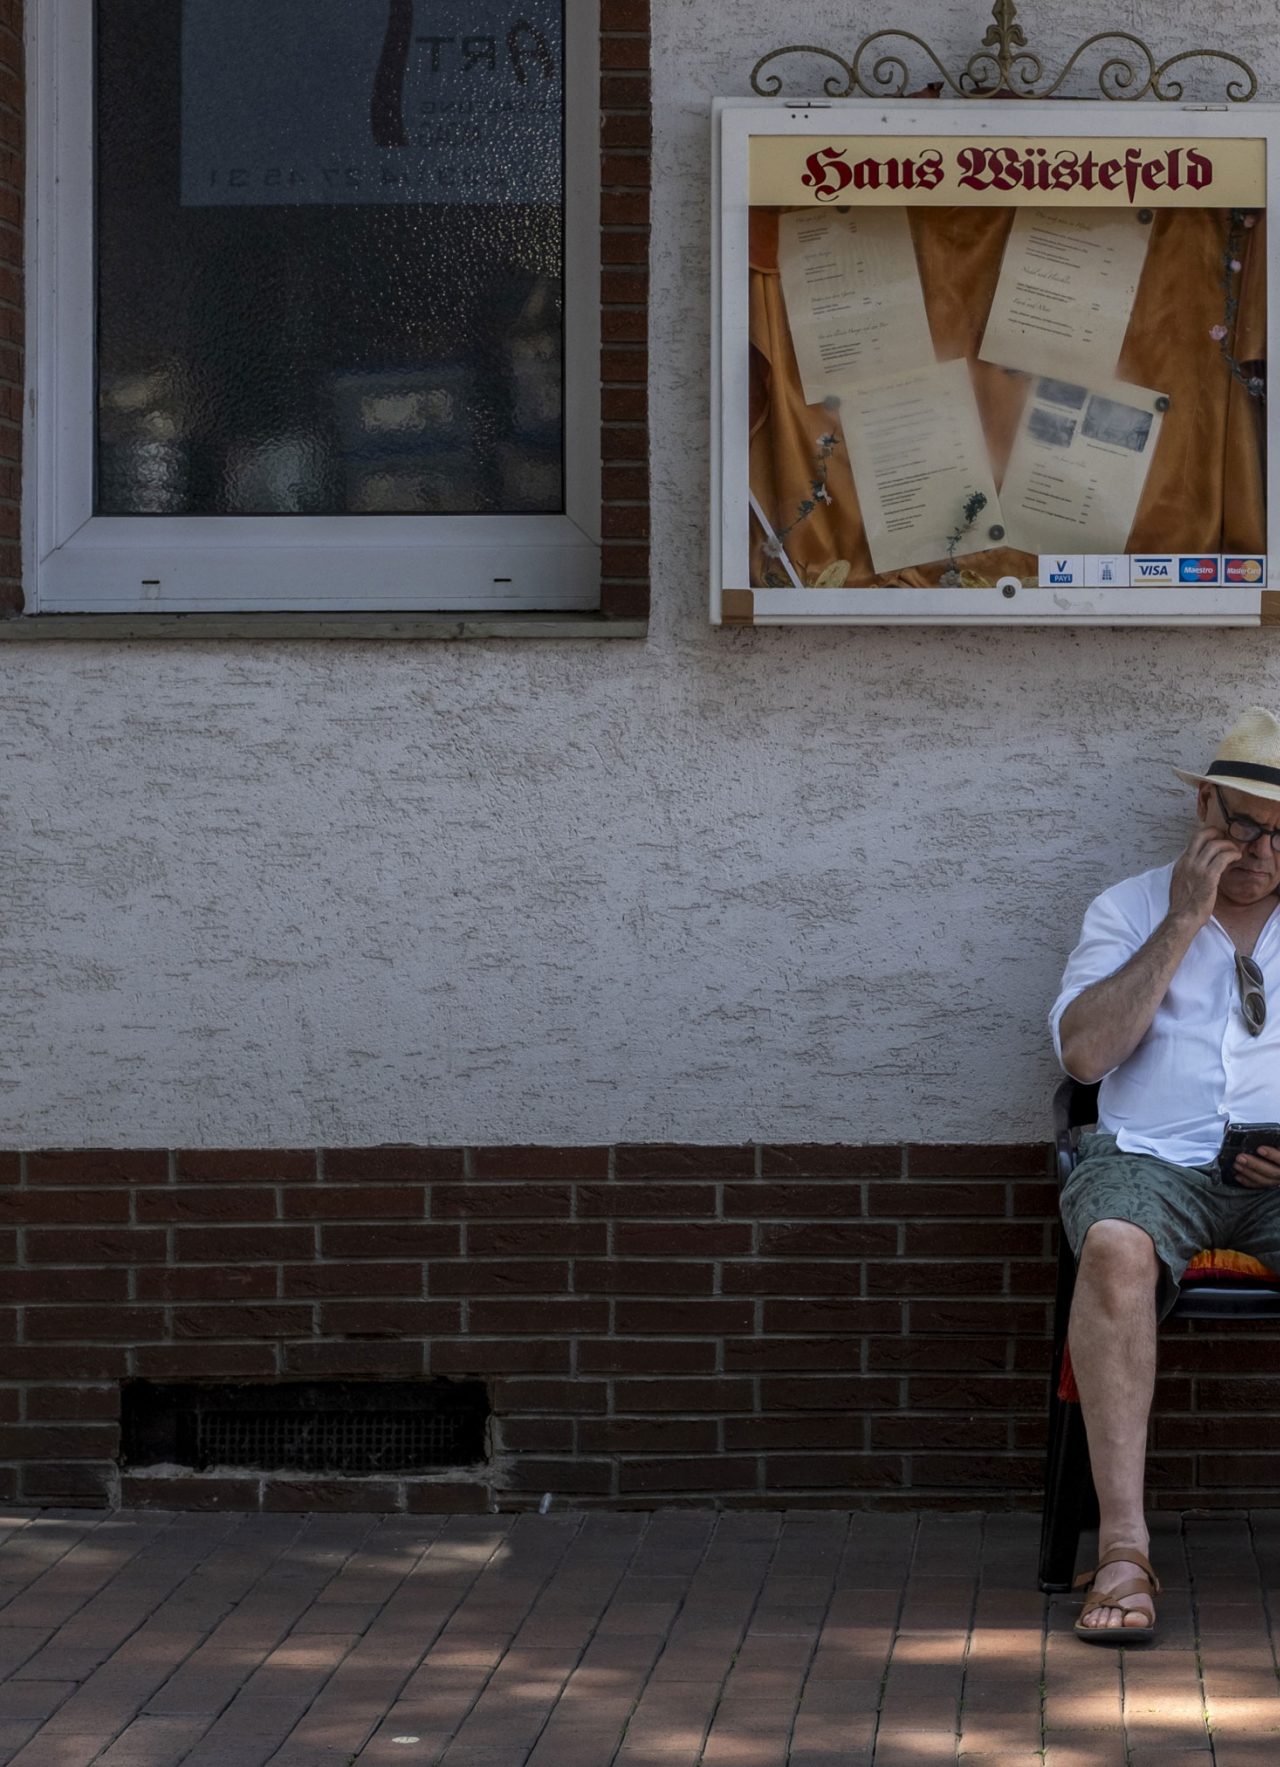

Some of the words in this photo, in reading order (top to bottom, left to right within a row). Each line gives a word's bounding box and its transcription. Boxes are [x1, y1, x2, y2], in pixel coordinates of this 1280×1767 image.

[801, 146, 945, 203] Haus
[956, 146, 1213, 204] Wüstefeld
[1139, 565, 1169, 576] VISA
[1184, 566, 1214, 575] Maestro
